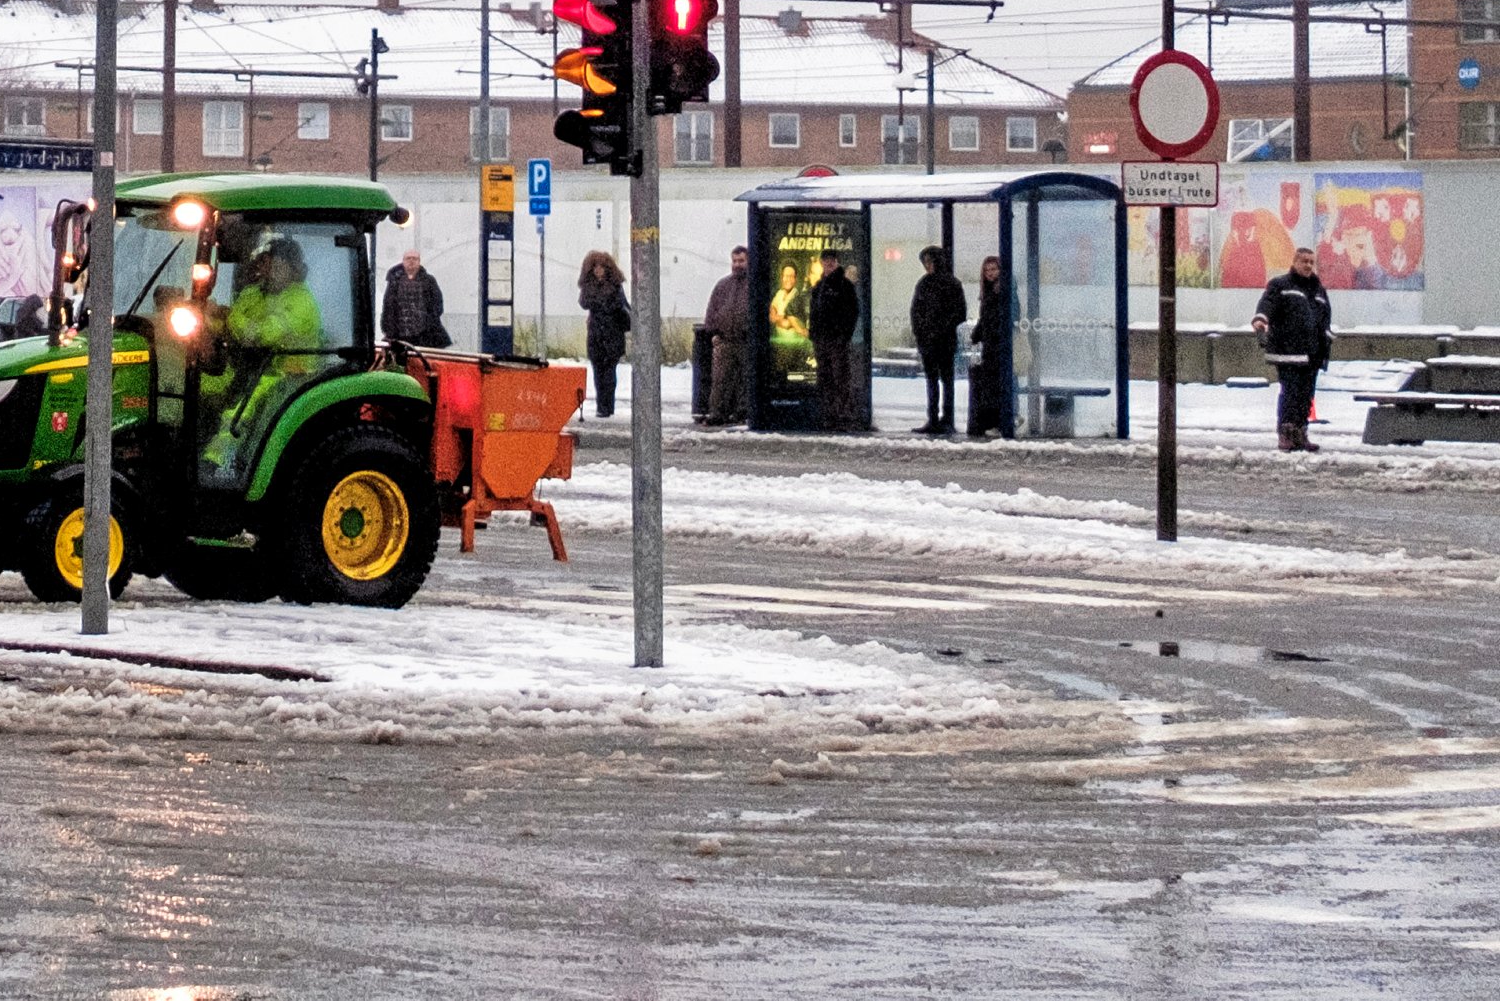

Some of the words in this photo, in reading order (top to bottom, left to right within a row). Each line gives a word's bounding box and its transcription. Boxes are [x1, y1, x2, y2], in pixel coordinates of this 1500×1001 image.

[533, 163, 547, 193] P
[1140, 170, 1201, 183] Undtaget
[1128, 186, 1172, 197] busser
[1186, 187, 1211, 198] rute
[795, 222, 813, 235] EN
[814, 222, 845, 236] HELT
[778, 236, 823, 250] ANDEN
[823, 237, 853, 250] LIGA
